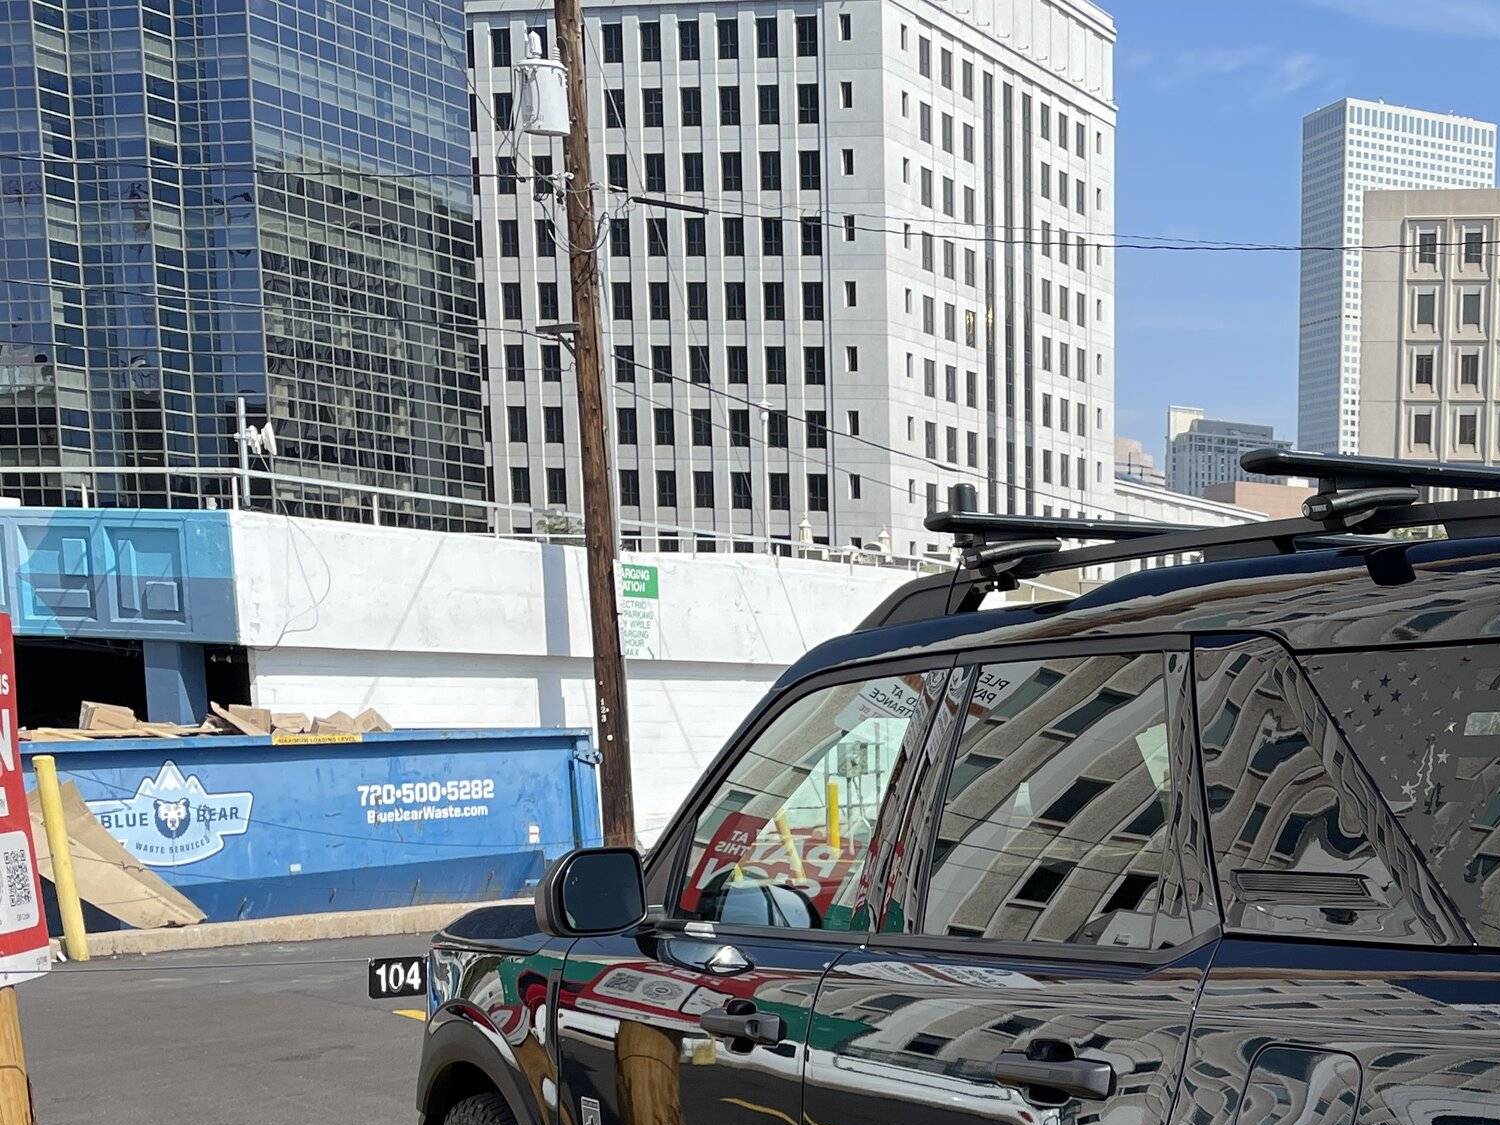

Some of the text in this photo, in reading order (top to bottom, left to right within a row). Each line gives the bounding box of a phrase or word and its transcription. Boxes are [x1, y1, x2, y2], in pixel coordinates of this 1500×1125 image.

[622, 566, 650, 581] ARGING
[622, 580, 646, 593] ATION
[623, 600, 647, 610] CTRIC
[624, 630, 649, 639] ARGING
[101, 806, 239, 829] BLUE BEAR
[376, 961, 421, 992] 104
